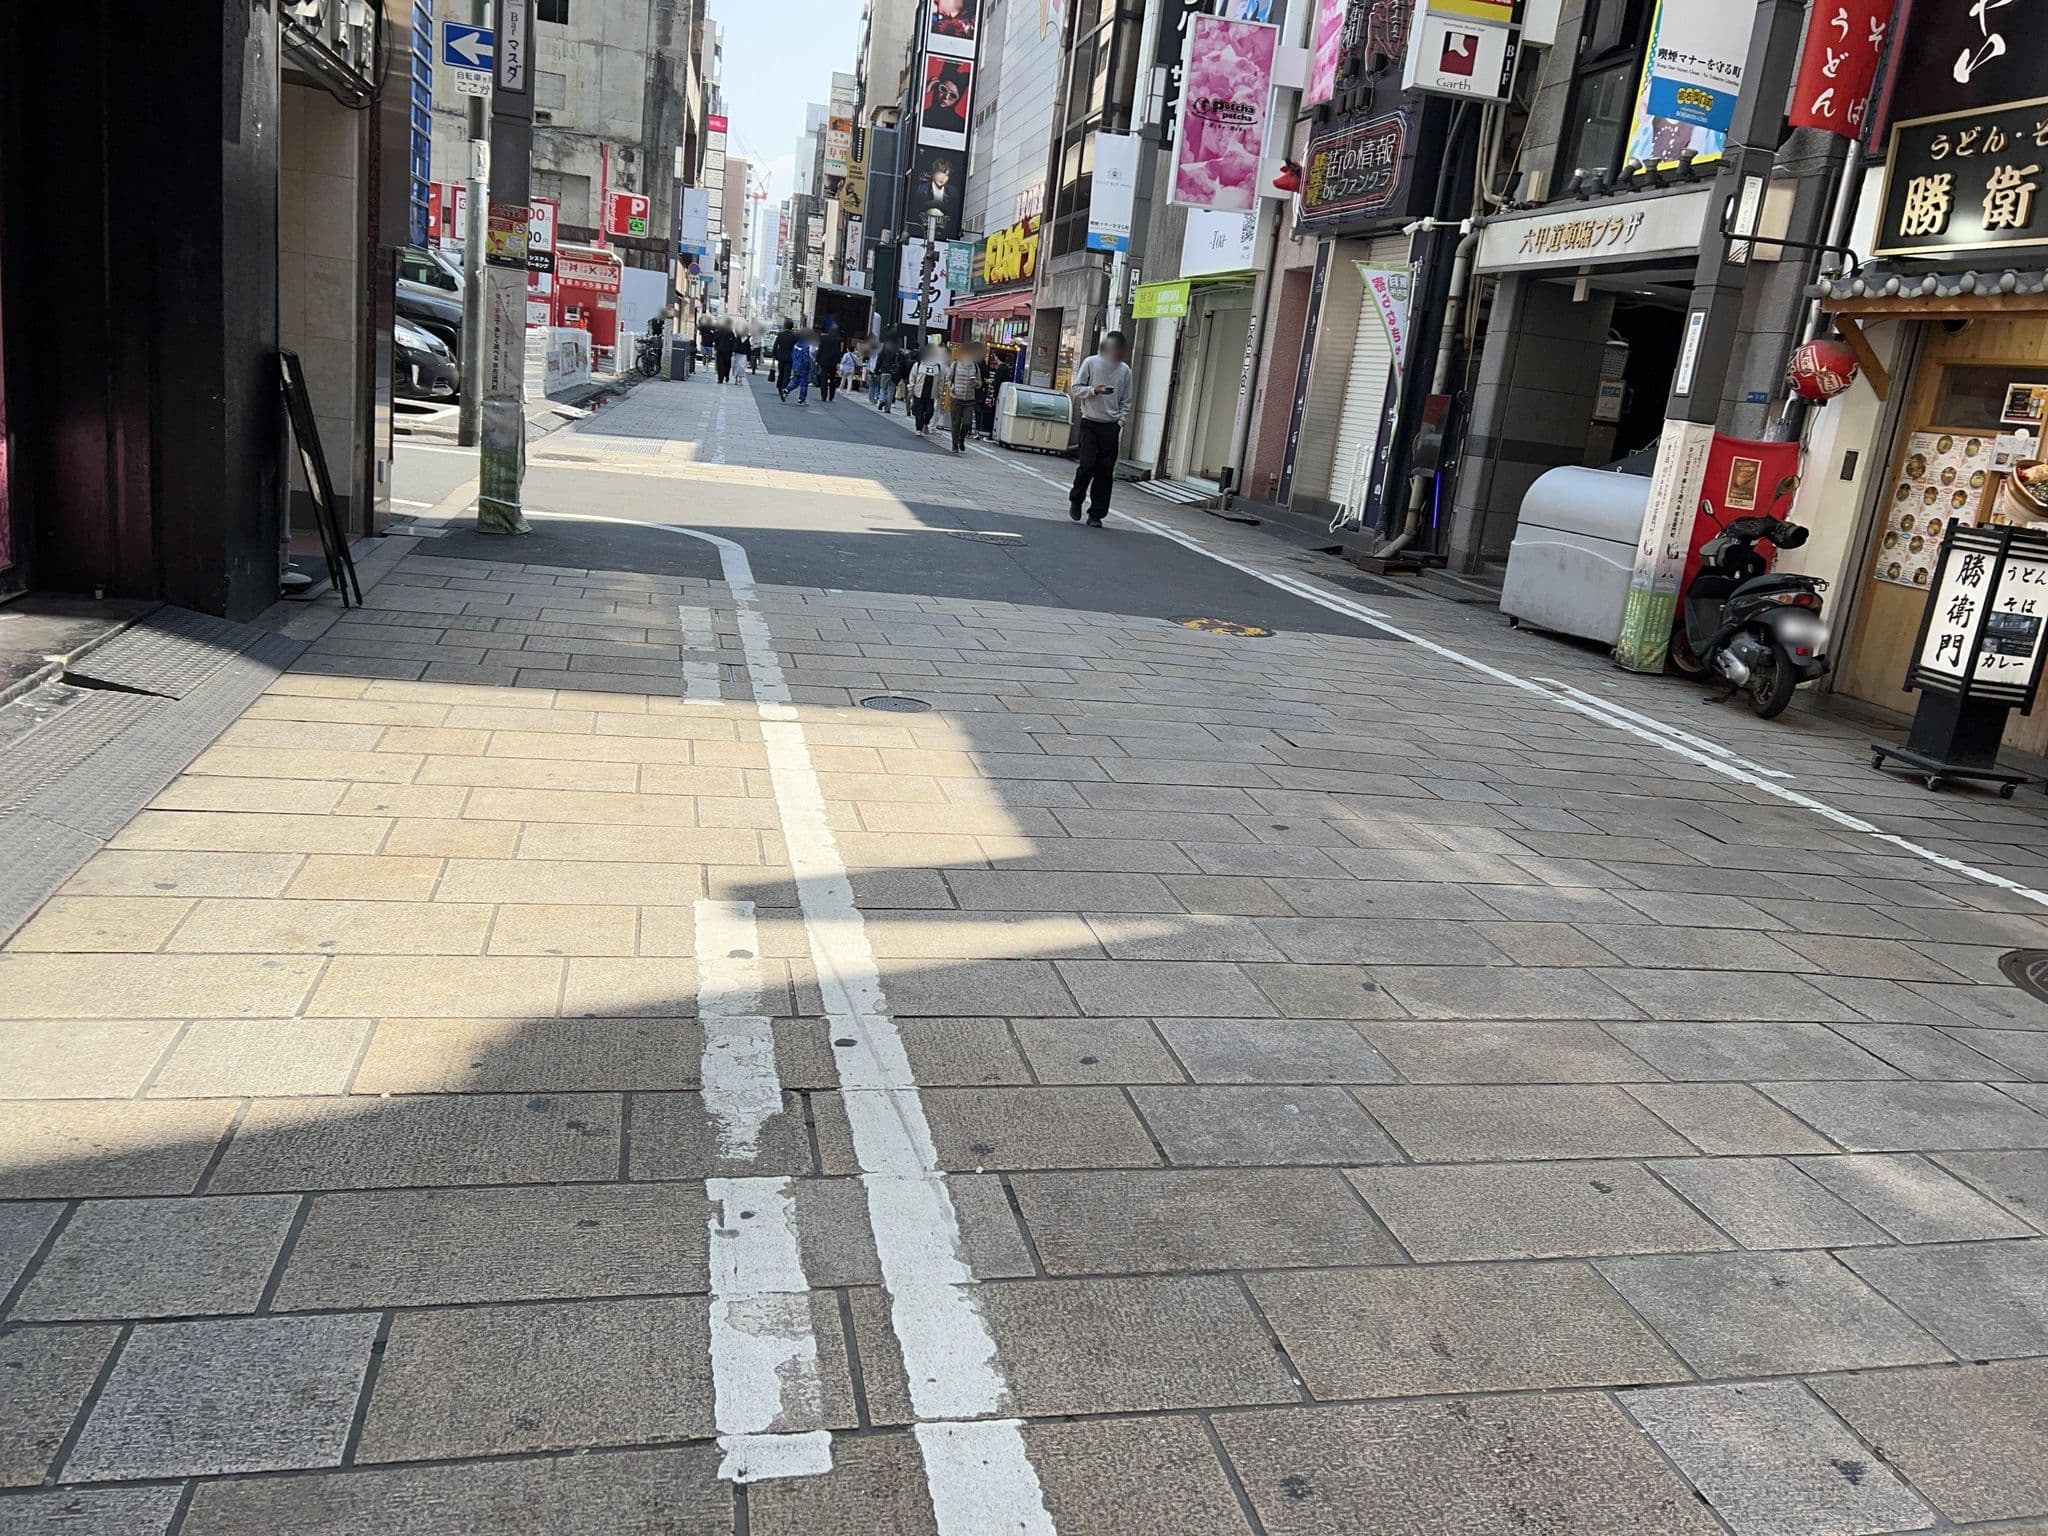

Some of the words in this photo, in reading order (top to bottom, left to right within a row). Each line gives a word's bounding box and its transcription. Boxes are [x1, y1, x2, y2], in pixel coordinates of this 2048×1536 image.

[507, 40, 522, 83] マスダ
[1658, 48, 1742, 78] 喫煙マナーを守る町
[1811, 7, 1849, 118] うどん
[1436, 77, 1471, 91] Garth
[1327, 133, 1397, 180] 街の情報
[631, 198, 645, 215] P
[1519, 211, 1645, 254] 六甲道頓堀プラザ
[2008, 566, 2047, 586] うどん
[1936, 554, 1985, 667] 勝衛門
[2004, 597, 2037, 614] そば
[1981, 654, 2025, 669] カレー
